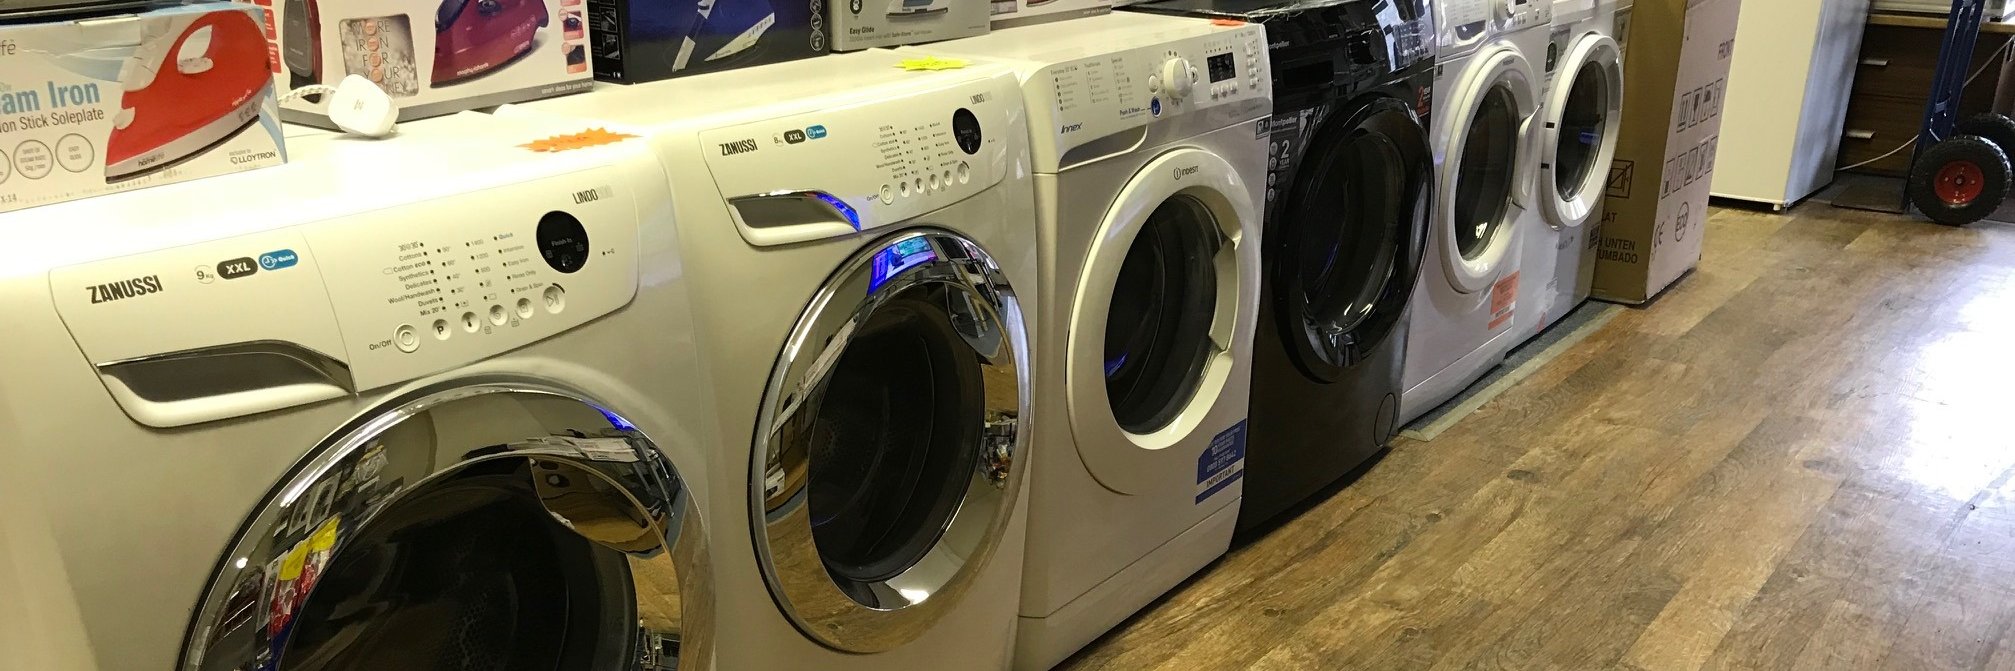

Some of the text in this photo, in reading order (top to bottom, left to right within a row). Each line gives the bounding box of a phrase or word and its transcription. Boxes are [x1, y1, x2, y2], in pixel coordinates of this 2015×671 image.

[47, 80, 101, 109] Iron
[19, 114, 49, 131] Stick
[50, 107, 105, 127] Soleplate
[1061, 121, 1083, 135] Innex
[787, 132, 803, 142] XXL
[718, 138, 758, 156] ZANUSSI
[1280, 139, 1290, 160] 2
[237, 150, 277, 164] LLOYTRON
[1604, 238, 1636, 251] UNTEN
[398, 252, 422, 262] Cottons
[225, 261, 252, 275] XXL
[393, 260, 426, 273] Cotton eco
[398, 270, 430, 282] Synthetics
[86, 274, 163, 304] ZANUSSI
[404, 280, 433, 291] Delicates
[368, 339, 393, 351] On/Off
[1206, 464, 1236, 488] IMPORTANT
